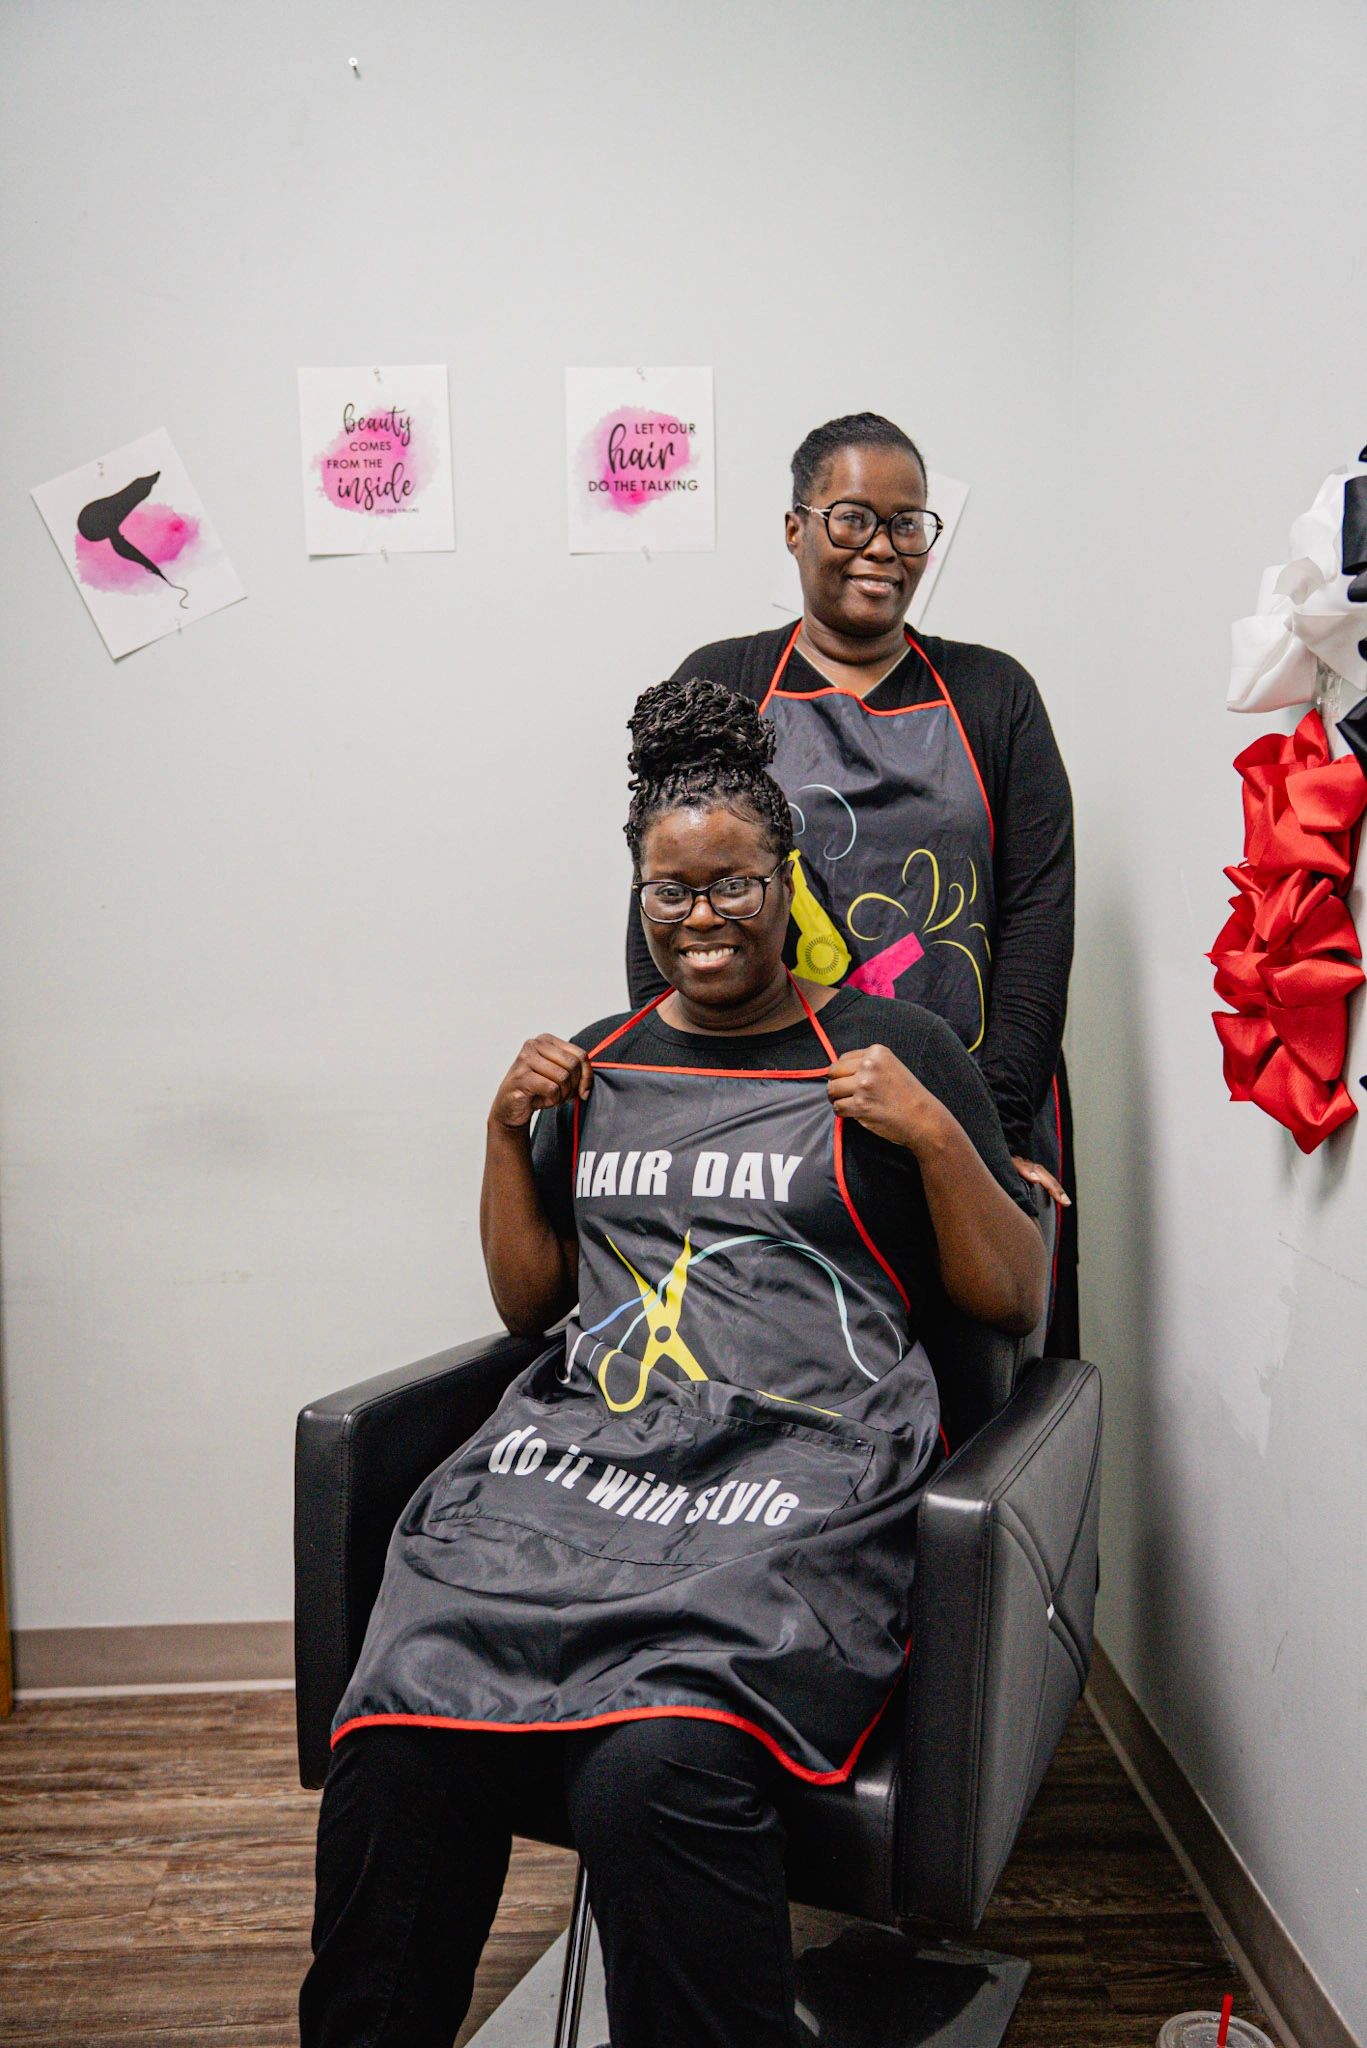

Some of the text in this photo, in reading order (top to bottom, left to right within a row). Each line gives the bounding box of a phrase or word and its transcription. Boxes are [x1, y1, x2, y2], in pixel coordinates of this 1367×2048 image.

[343, 403, 413, 447] beauty
[350, 442, 392, 452] COMES
[635, 423, 697, 434] LET YOUR
[327, 459, 383, 469] FROM THE
[608, 423, 675, 474] hair
[337, 462, 414, 511] inside
[588, 480, 698, 492] DO THE TALKING
[575, 1150, 804, 1203] HAIR DAY
[488, 1425, 800, 1526] do it with style
